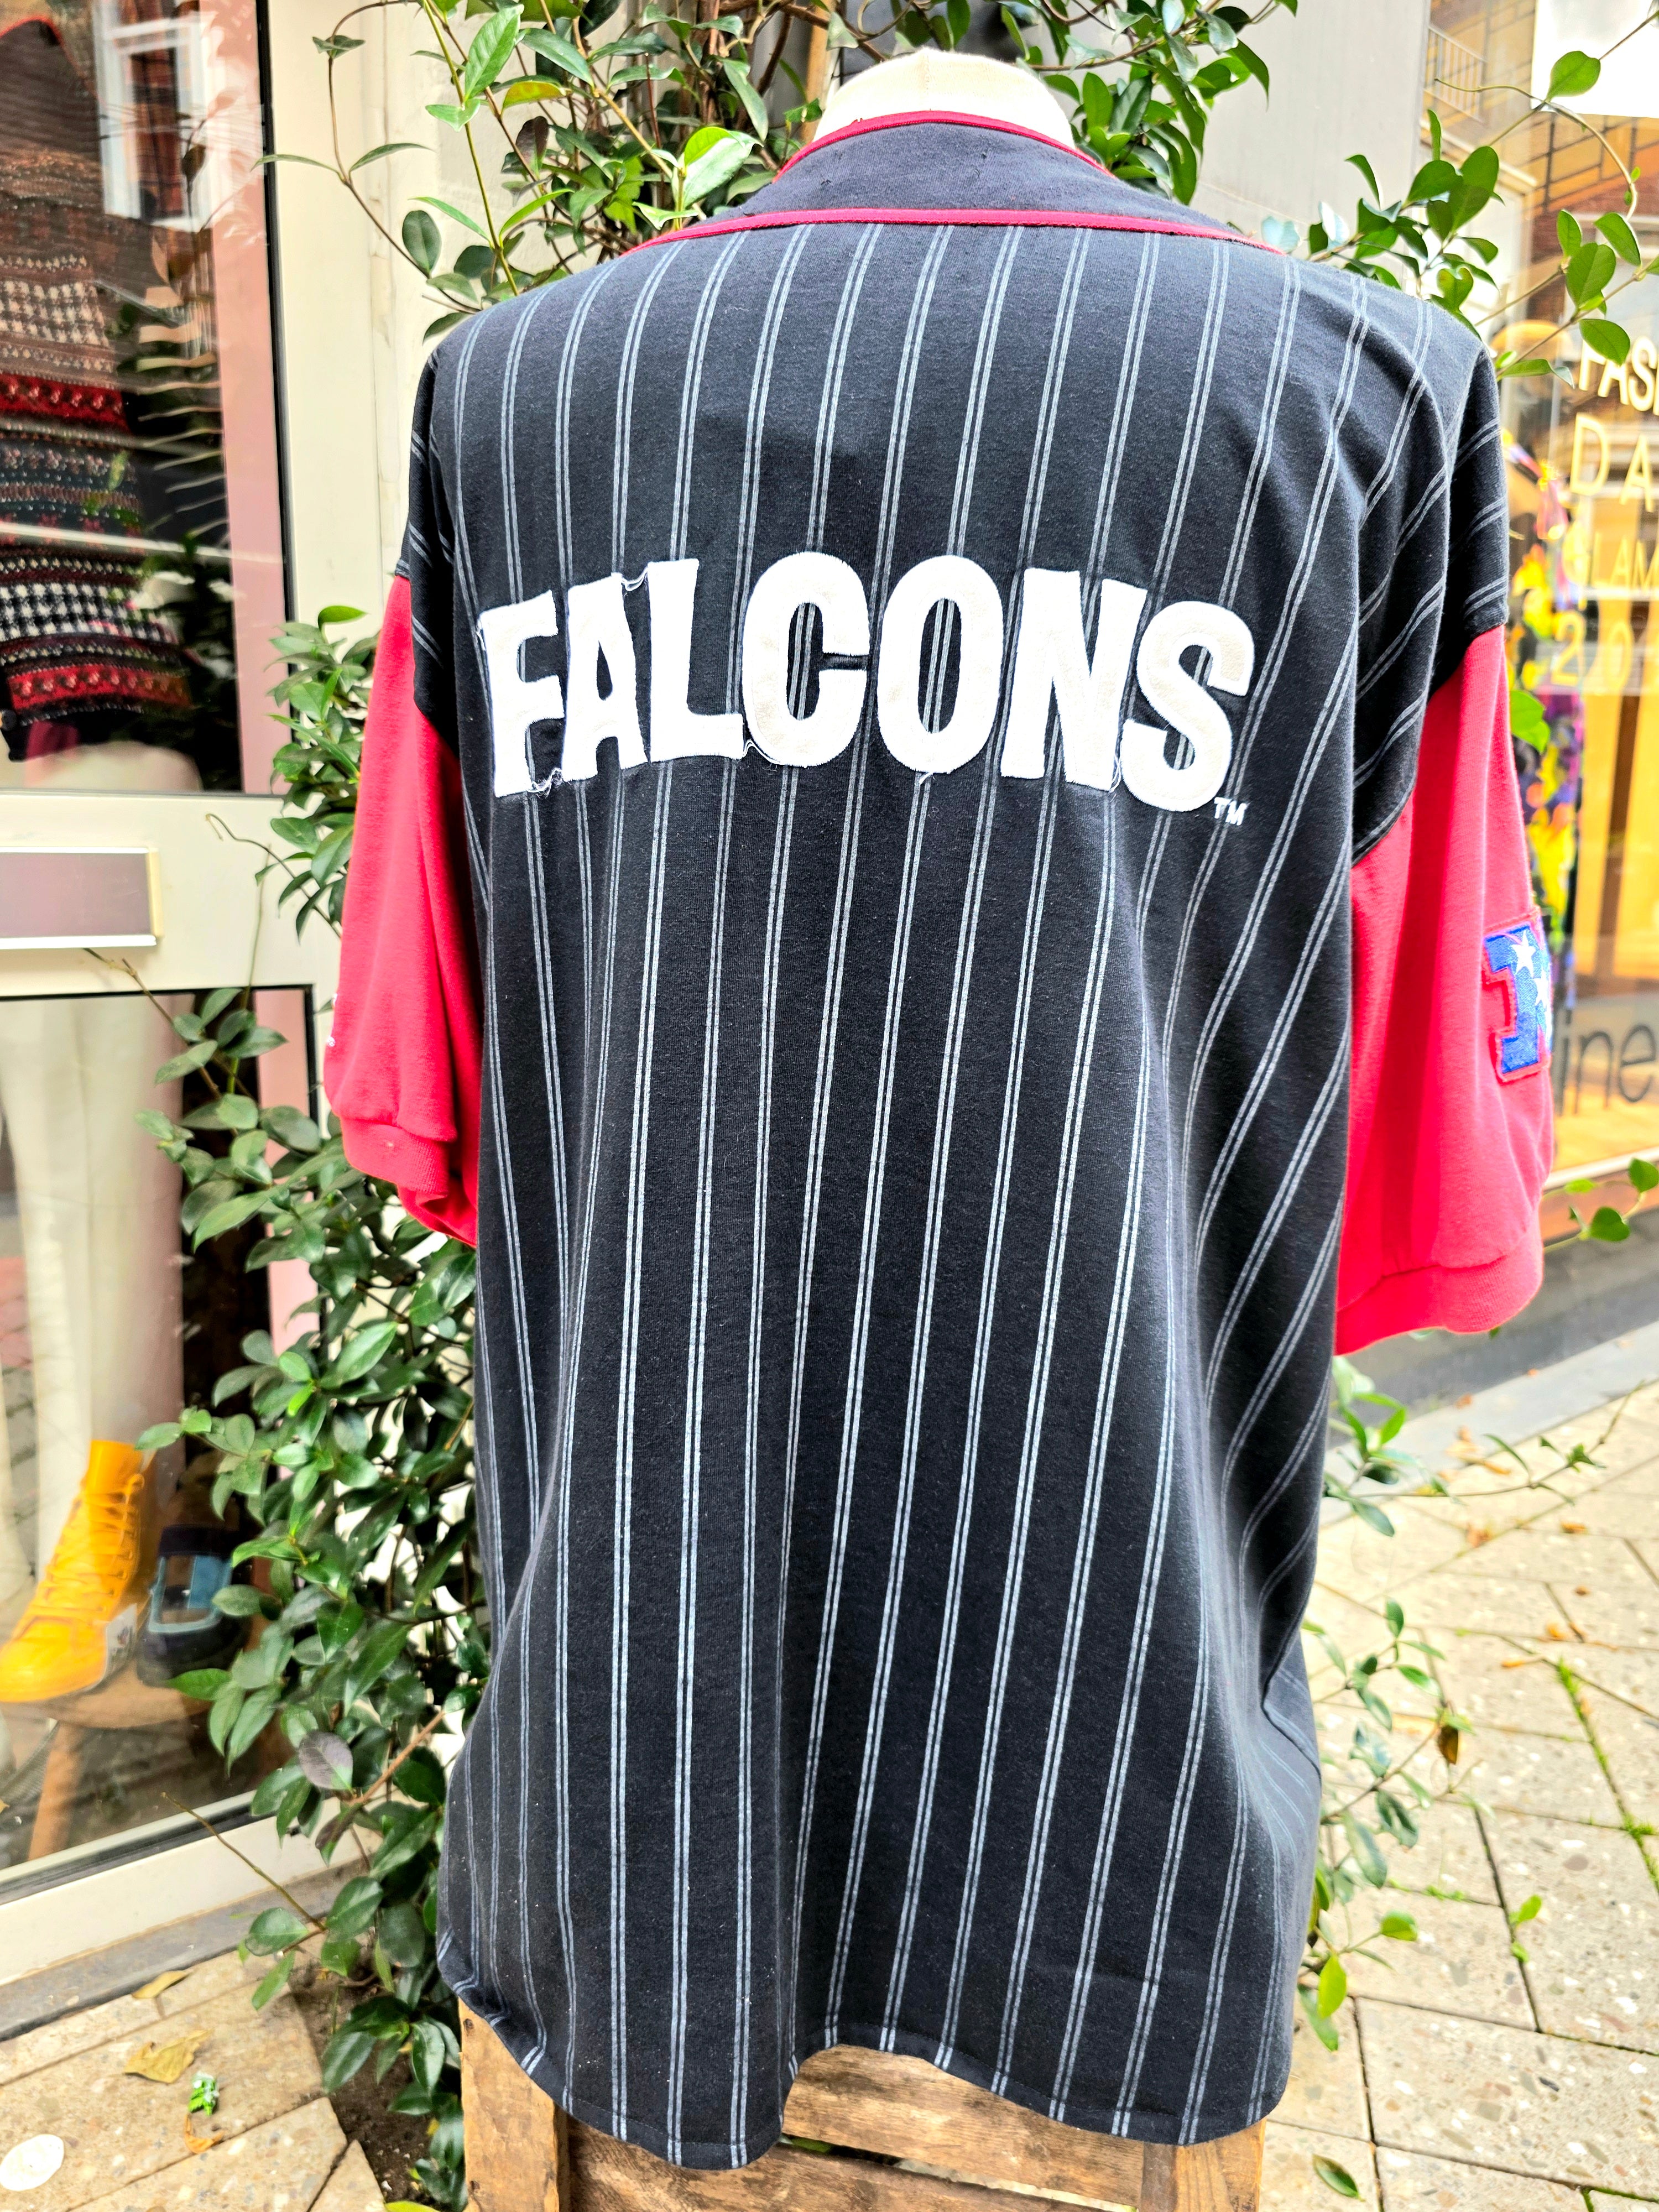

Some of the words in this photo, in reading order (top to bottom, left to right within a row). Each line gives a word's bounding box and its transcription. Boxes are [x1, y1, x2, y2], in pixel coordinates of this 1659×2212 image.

[1579, 336, 1659, 416] FAS
[478, 551, 1255, 812] FALCONS
[1213, 796, 1249, 826] TM
